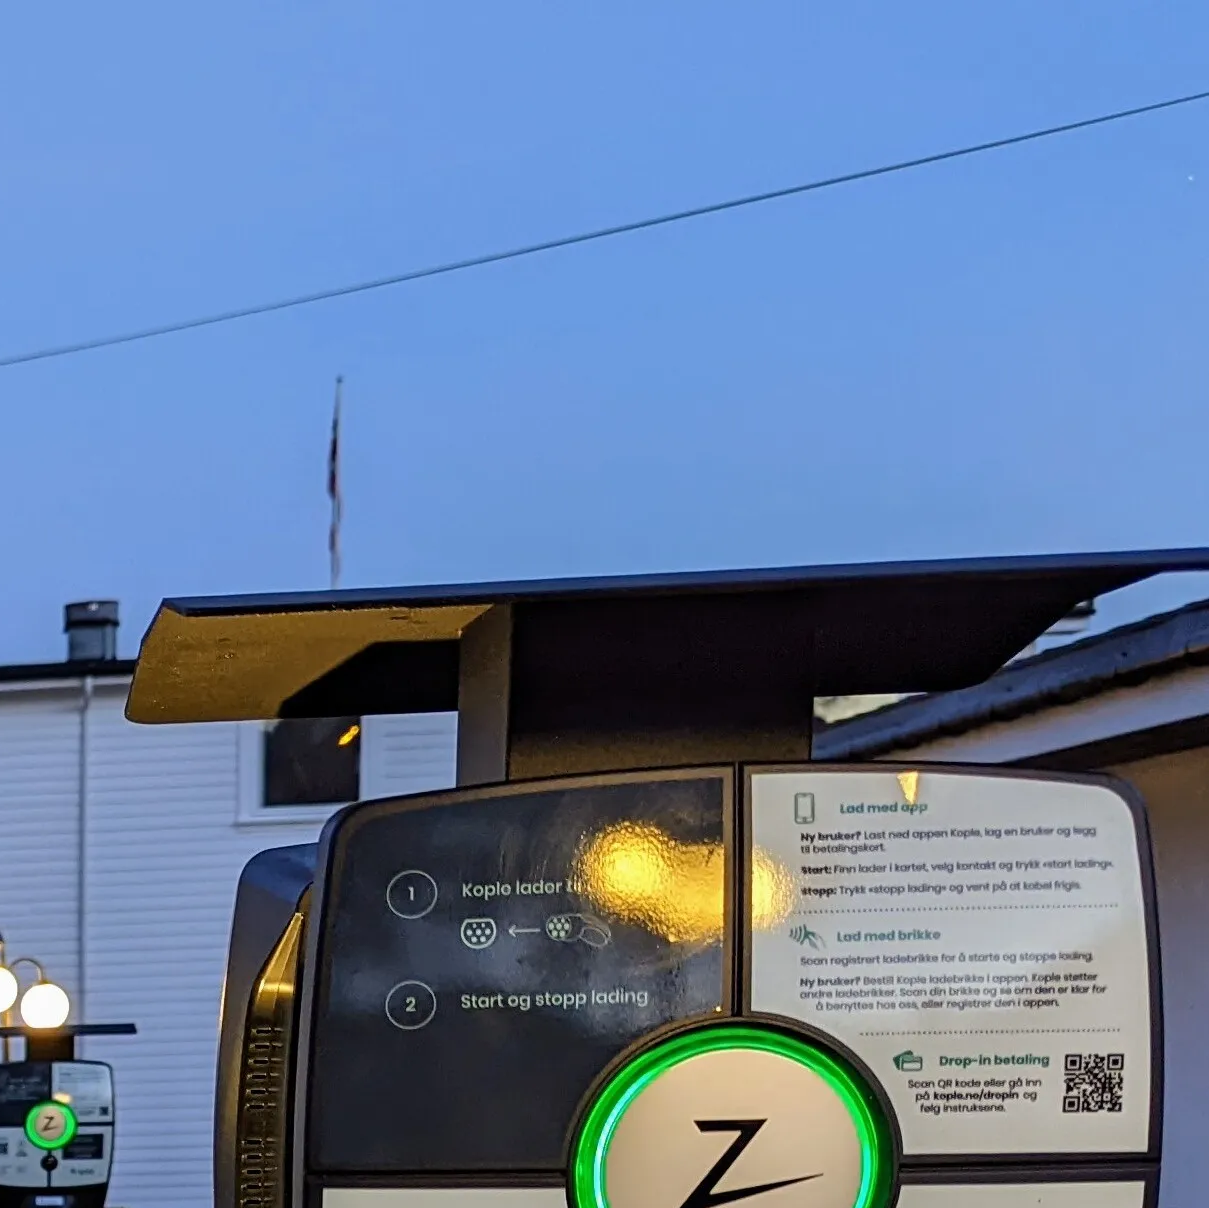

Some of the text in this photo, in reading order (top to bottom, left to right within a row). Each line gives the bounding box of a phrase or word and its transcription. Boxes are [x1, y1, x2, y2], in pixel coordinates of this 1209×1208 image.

[840, 802, 928, 815] Lad med app
[801, 833, 815, 843] Ny
[818, 832, 861, 841] bruker?
[888, 830, 910, 839] ned
[912, 830, 948, 841] appen
[1004, 828, 1018, 836] en
[1020, 827, 1054, 836] bruker
[1057, 827, 1071, 838] og
[858, 863, 887, 873] lader
[999, 861, 1013, 872] og
[408, 886, 415, 901] 1
[462, 881, 512, 900] Kople
[516, 880, 562, 895] lader
[949, 883, 963, 894] og
[992, 881, 1007, 893] på
[837, 929, 941, 942] Lad med brikke
[800, 956, 828, 966] Scan
[830, 955, 880, 967] registrert
[883, 954, 938, 964] ladebrikke
[1003, 954, 1016, 964] og
[817, 976, 860, 986] bruker?
[405, 989, 648, 1013] 2 Start og stopp lading
[939, 1053, 1050, 1068] Drop-in betaling
[908, 1077, 1042, 1089] Scan QR kode eller gå inn
[915, 1091, 930, 1102] på
[1023, 1092, 1037, 1102] og
